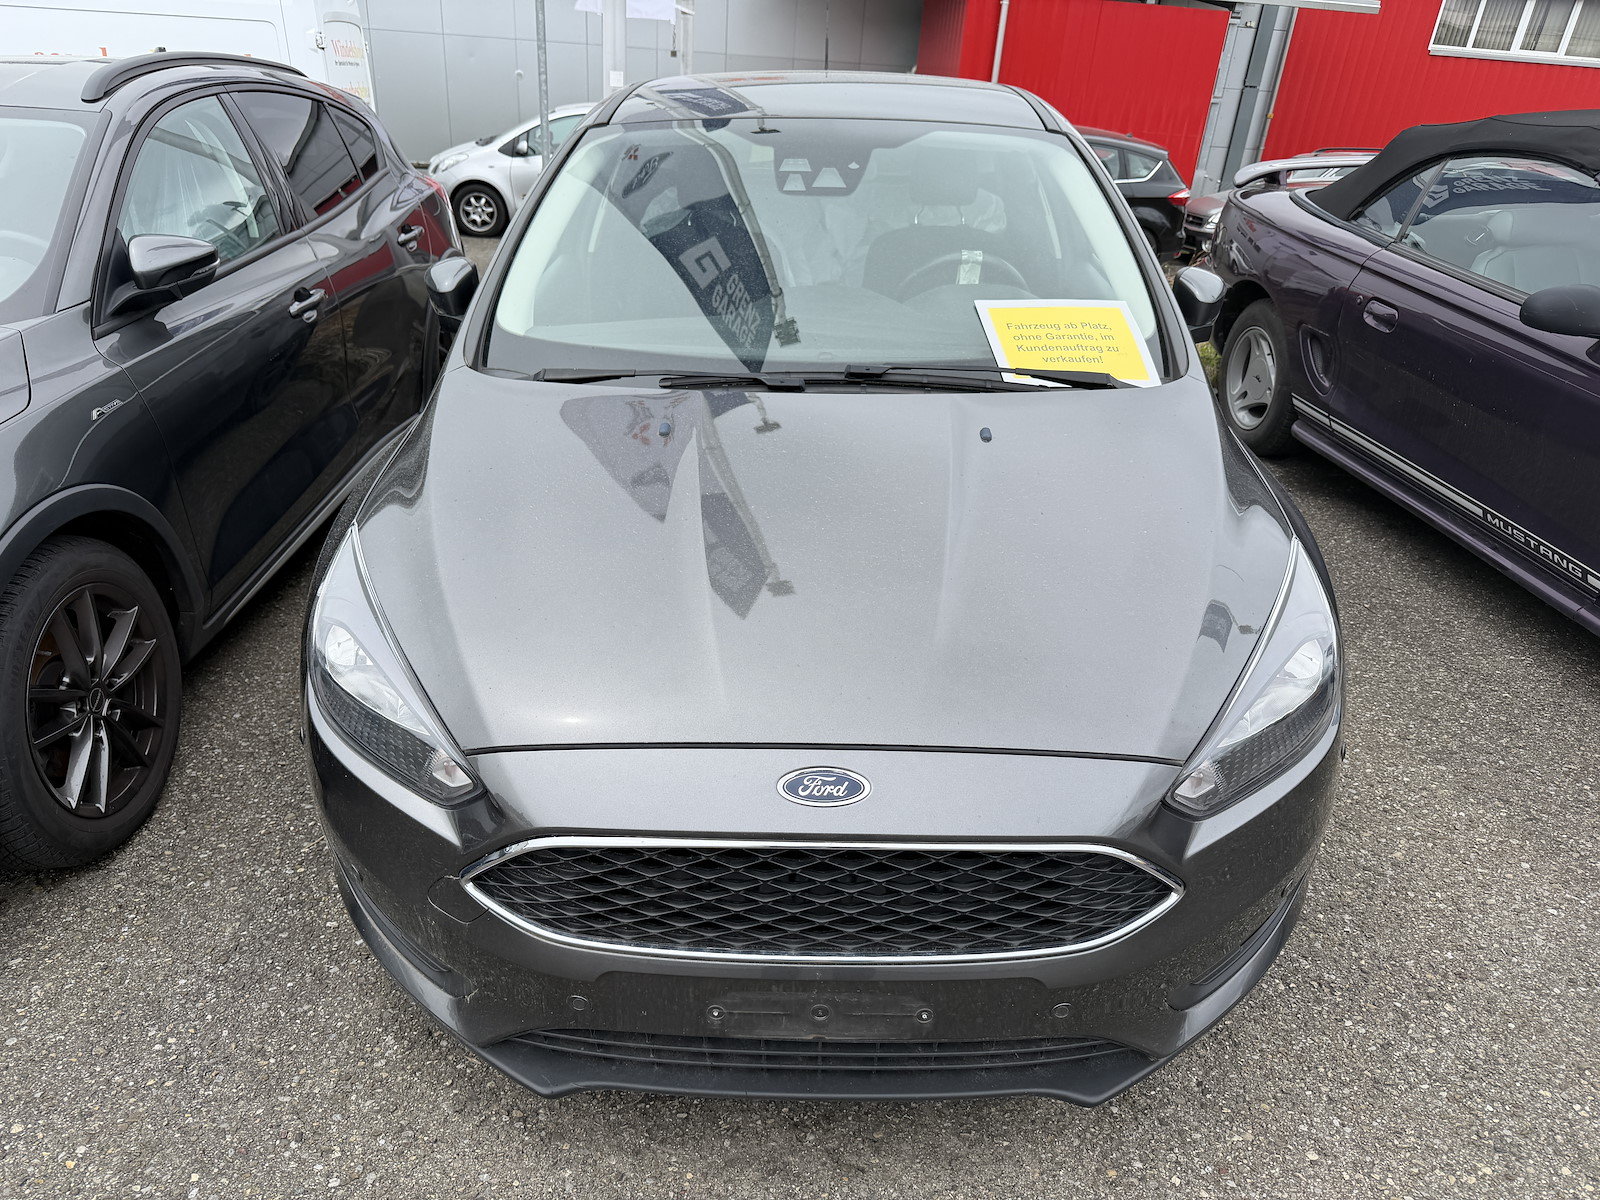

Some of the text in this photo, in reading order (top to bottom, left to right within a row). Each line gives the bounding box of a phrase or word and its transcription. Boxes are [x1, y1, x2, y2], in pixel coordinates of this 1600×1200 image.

[726, 273, 761, 335] GRENZ
[711, 284, 755, 348] GARAGE
[1006, 321, 1113, 331] Fahrzeug ab Platz,
[1013, 333, 1115, 341] ohne Garantie, im
[1016, 344, 1104, 354] Kundenauftrag
[1042, 355, 1104, 364] verkaufen!
[1487, 513, 1582, 578] MUSTANG
[797, 775, 849, 797] Ford
